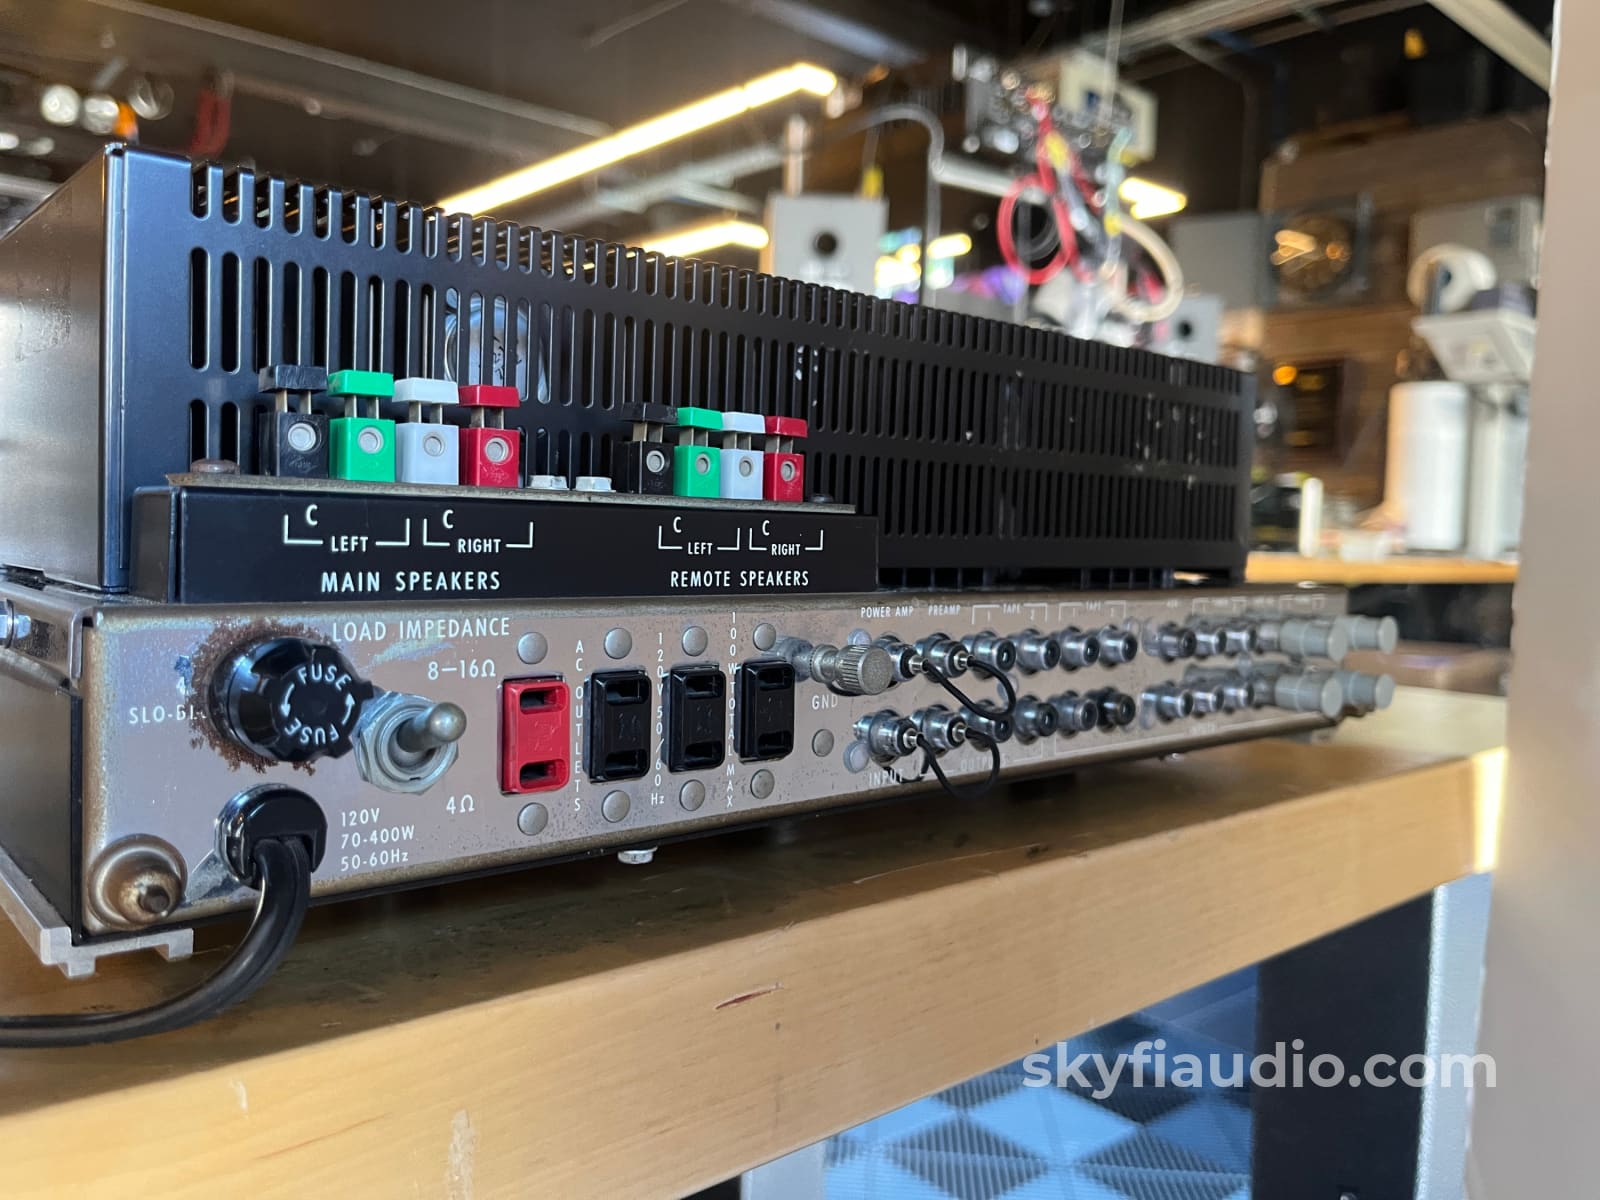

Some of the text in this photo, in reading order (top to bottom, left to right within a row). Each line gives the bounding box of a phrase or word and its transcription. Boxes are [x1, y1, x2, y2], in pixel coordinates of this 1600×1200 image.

[305, 504, 318, 526] C
[442, 509, 454, 529] C
[672, 516, 682, 533] C
[762, 520, 770, 536] C
[331, 536, 369, 552] LEFT
[458, 538, 501, 553] RIGHT
[687, 542, 713, 555] LEFT
[771, 543, 801, 556] RIGHT
[321, 571, 501, 592] MAIN SPEAKERS
[670, 570, 809, 588] REMOTE SPEAKERS
[861, 606, 914, 618] POWER AMP
[928, 605, 961, 616] PREAMP
[332, 617, 510, 643] LOAD IMPEDANCE
[298, 663, 352, 691] FUSE
[811, 693, 839, 711] GND
[284, 717, 340, 745] FUSE
[574, 686, 584, 812] OUTLETS
[869, 769, 904, 787] INPUT
[341, 808, 380, 827] 120V
[341, 824, 415, 849] 70-400W
[340, 848, 409, 872] 50-60Hz
